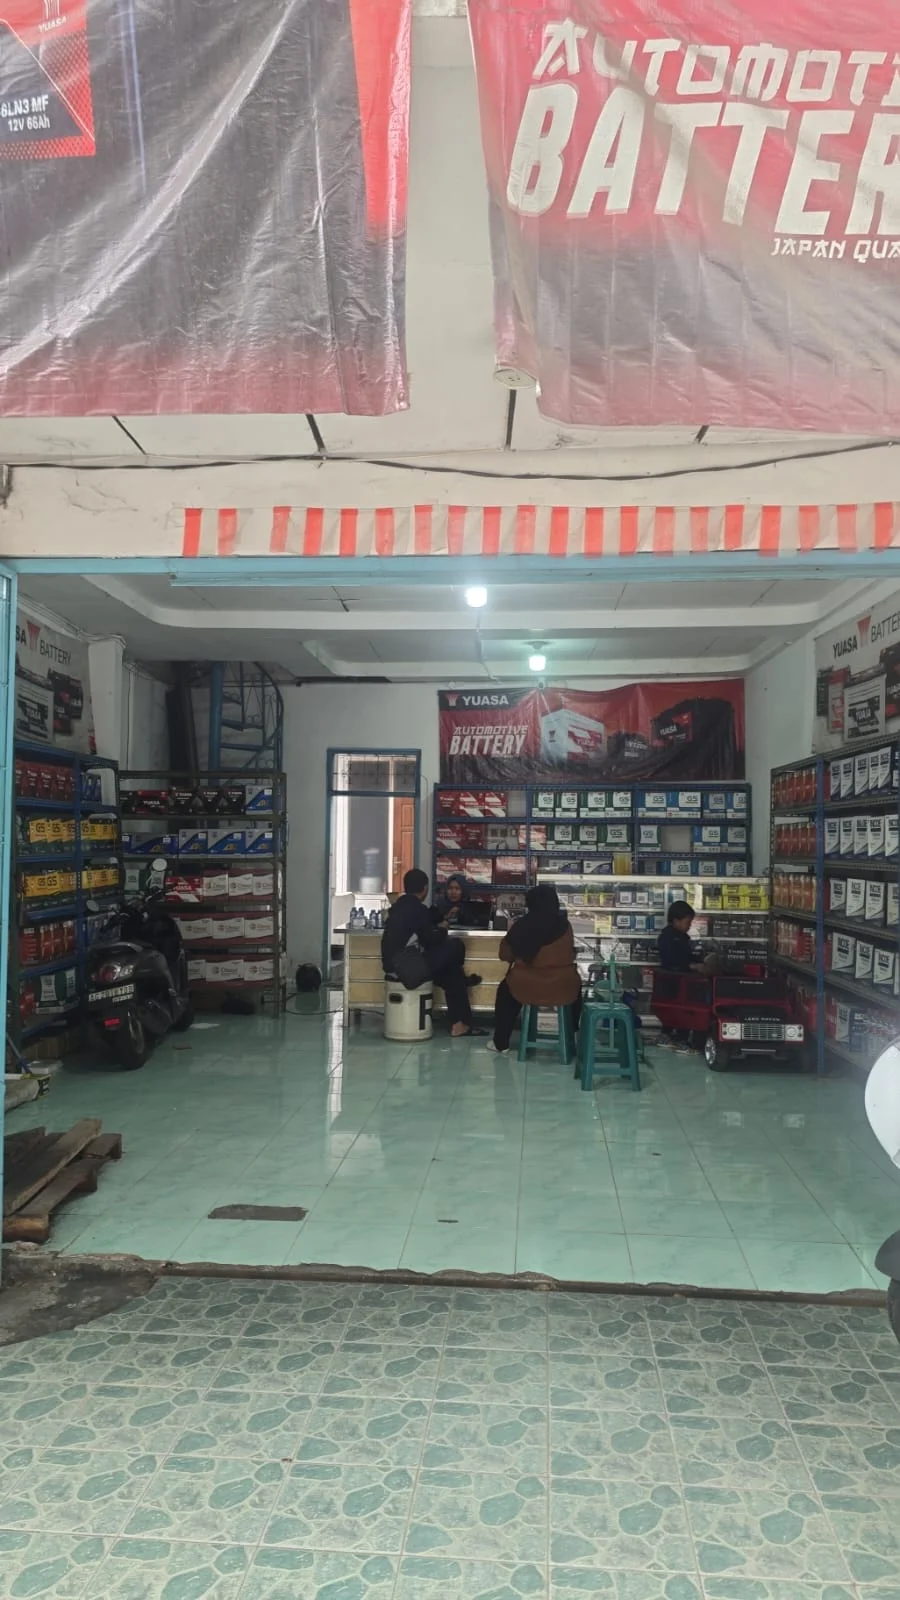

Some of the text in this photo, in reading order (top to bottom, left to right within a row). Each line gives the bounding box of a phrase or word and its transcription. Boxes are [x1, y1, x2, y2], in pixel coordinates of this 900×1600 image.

[38, 16, 67, 32] YUASA
[31, 94, 49, 113] MF
[8, 113, 51, 132] 12V 66Ah
[507, 83, 900, 236] BATTER
[771, 238, 900, 264] JAPAN QUA
[40, 639, 71, 665] BATTERY
[833, 636, 858, 659] YUASA
[462, 695, 509, 706] YUASA
[453, 724, 528, 736] AUTOMOTIVE
[449, 734, 526, 756] BATTERY
